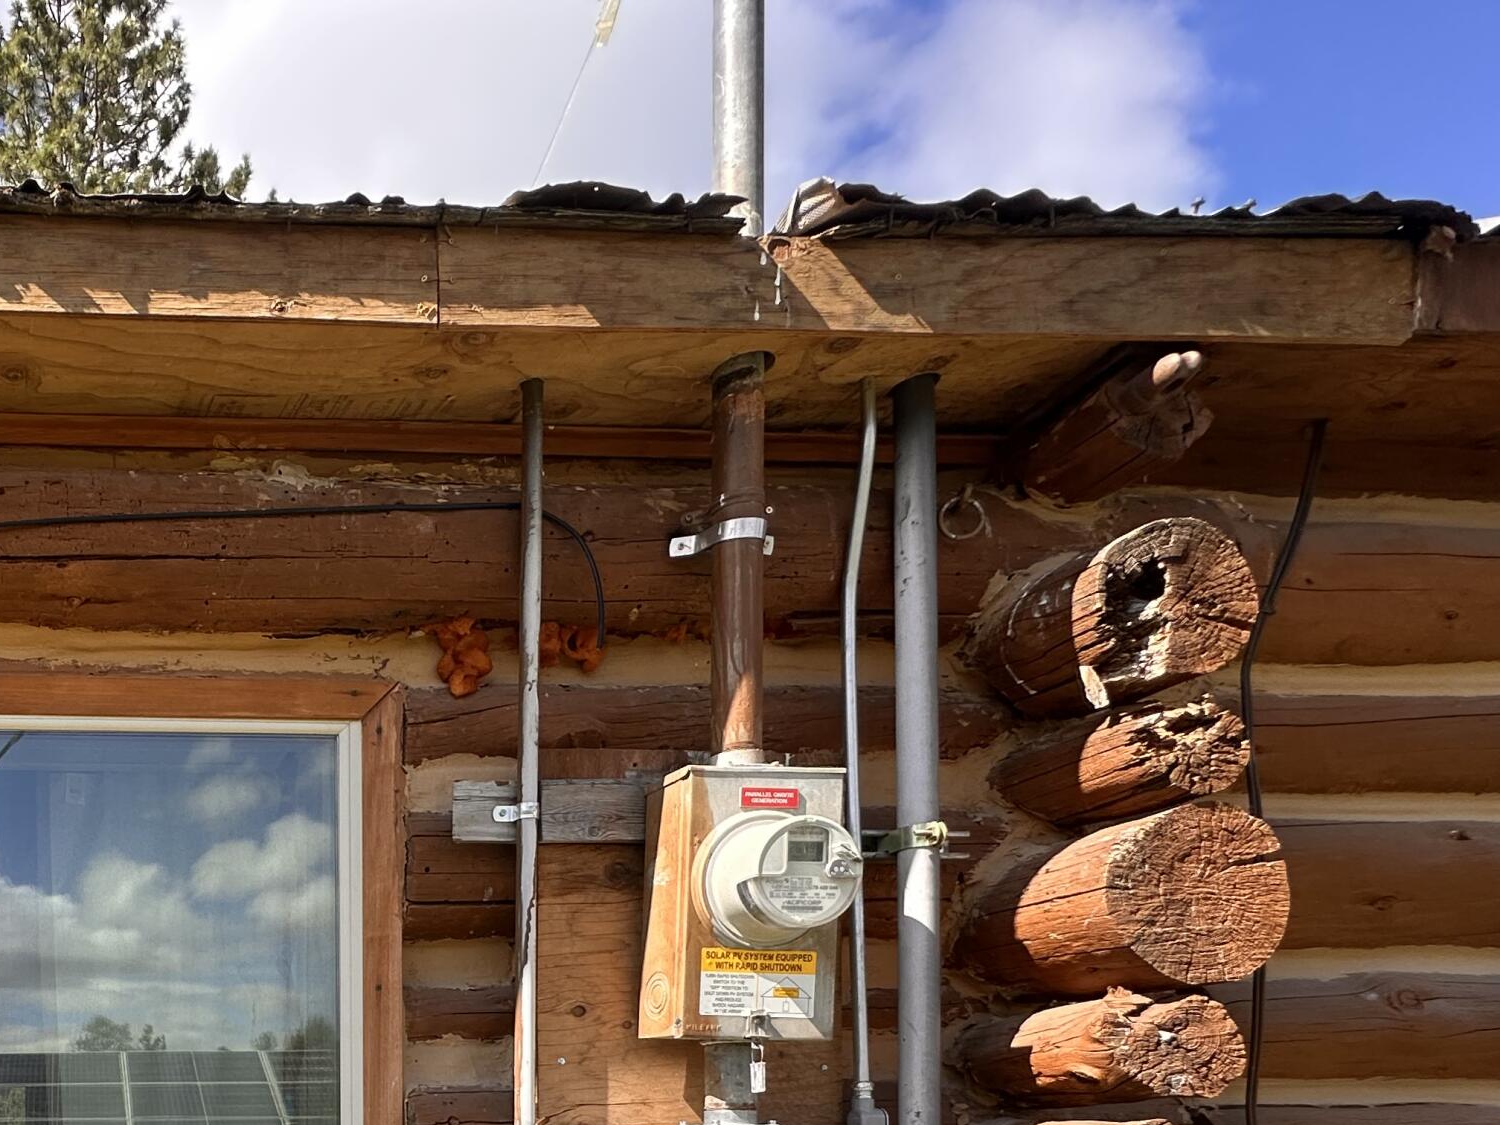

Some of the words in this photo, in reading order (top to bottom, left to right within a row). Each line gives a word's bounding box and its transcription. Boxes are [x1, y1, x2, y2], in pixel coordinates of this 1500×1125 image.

[706, 951, 730, 960] SOLAR
[731, 952, 742, 960] PV
[744, 952, 774, 961] SYSTEM
[776, 953, 813, 962] EQUIPPED
[715, 961, 734, 969] WITH
[735, 962, 758, 970] RAPID
[760, 963, 802, 972] SHUTDOWN
